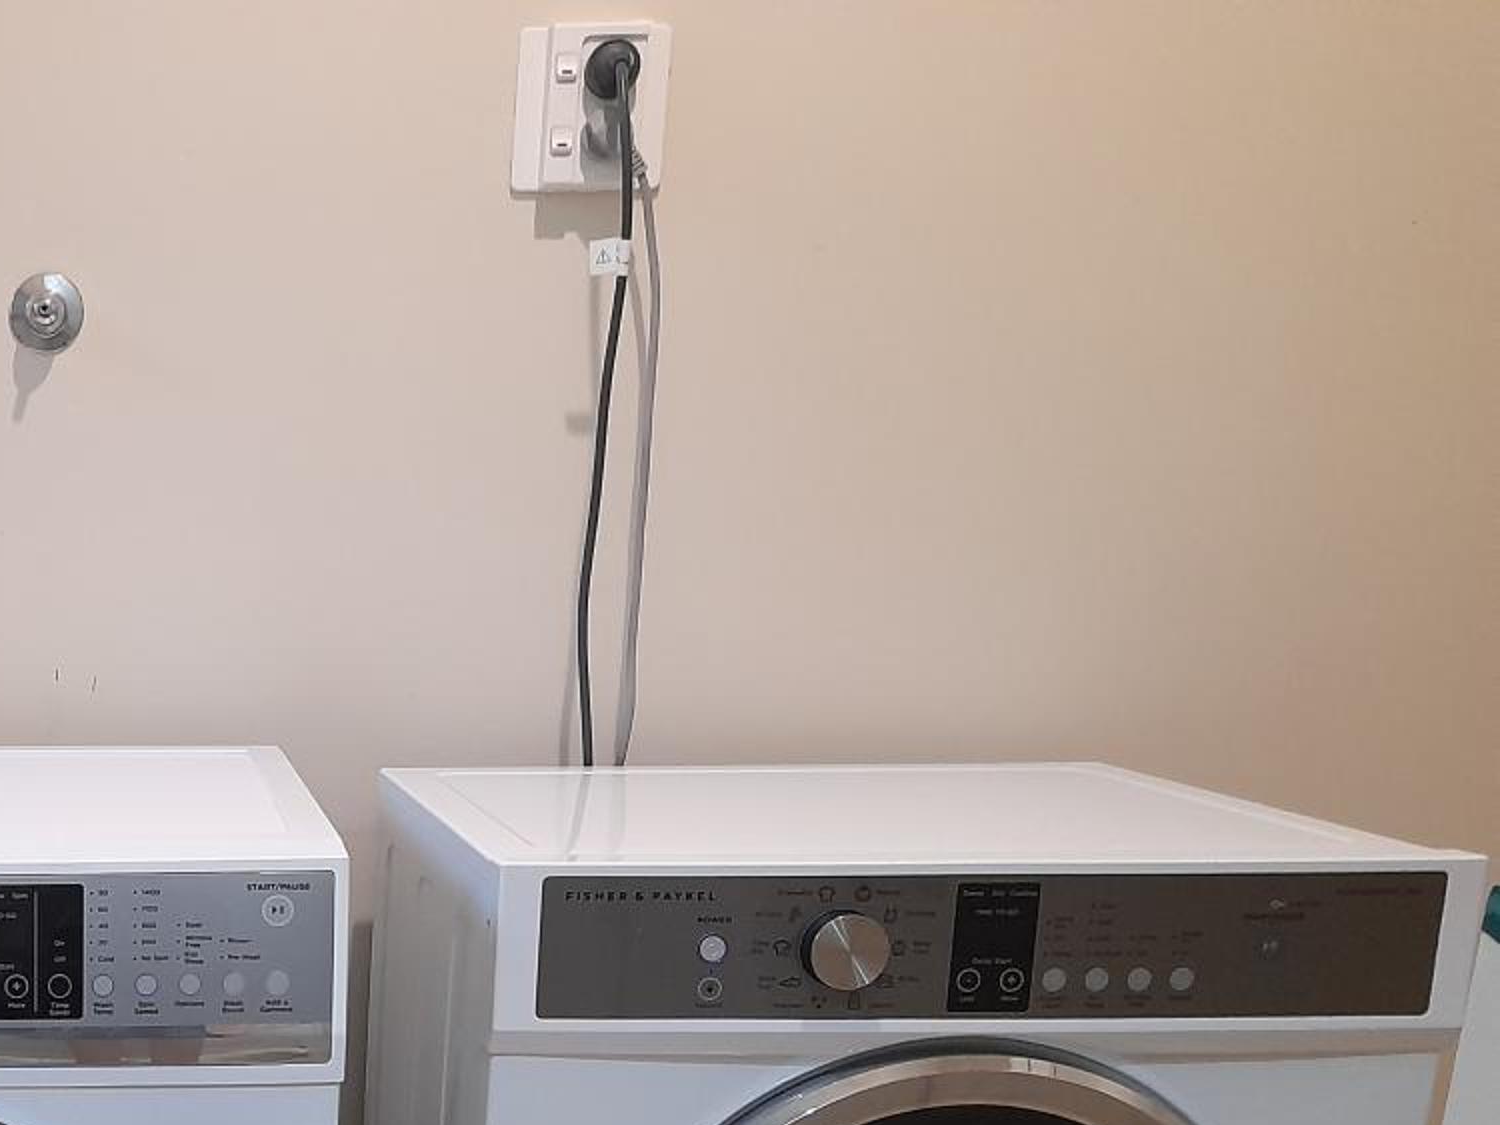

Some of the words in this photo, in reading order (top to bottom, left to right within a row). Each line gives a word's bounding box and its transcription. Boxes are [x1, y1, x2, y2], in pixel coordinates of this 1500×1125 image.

[565, 891, 627, 901] FISHER
[635, 891, 645, 901] &
[653, 891, 717, 901] PAYKEL
